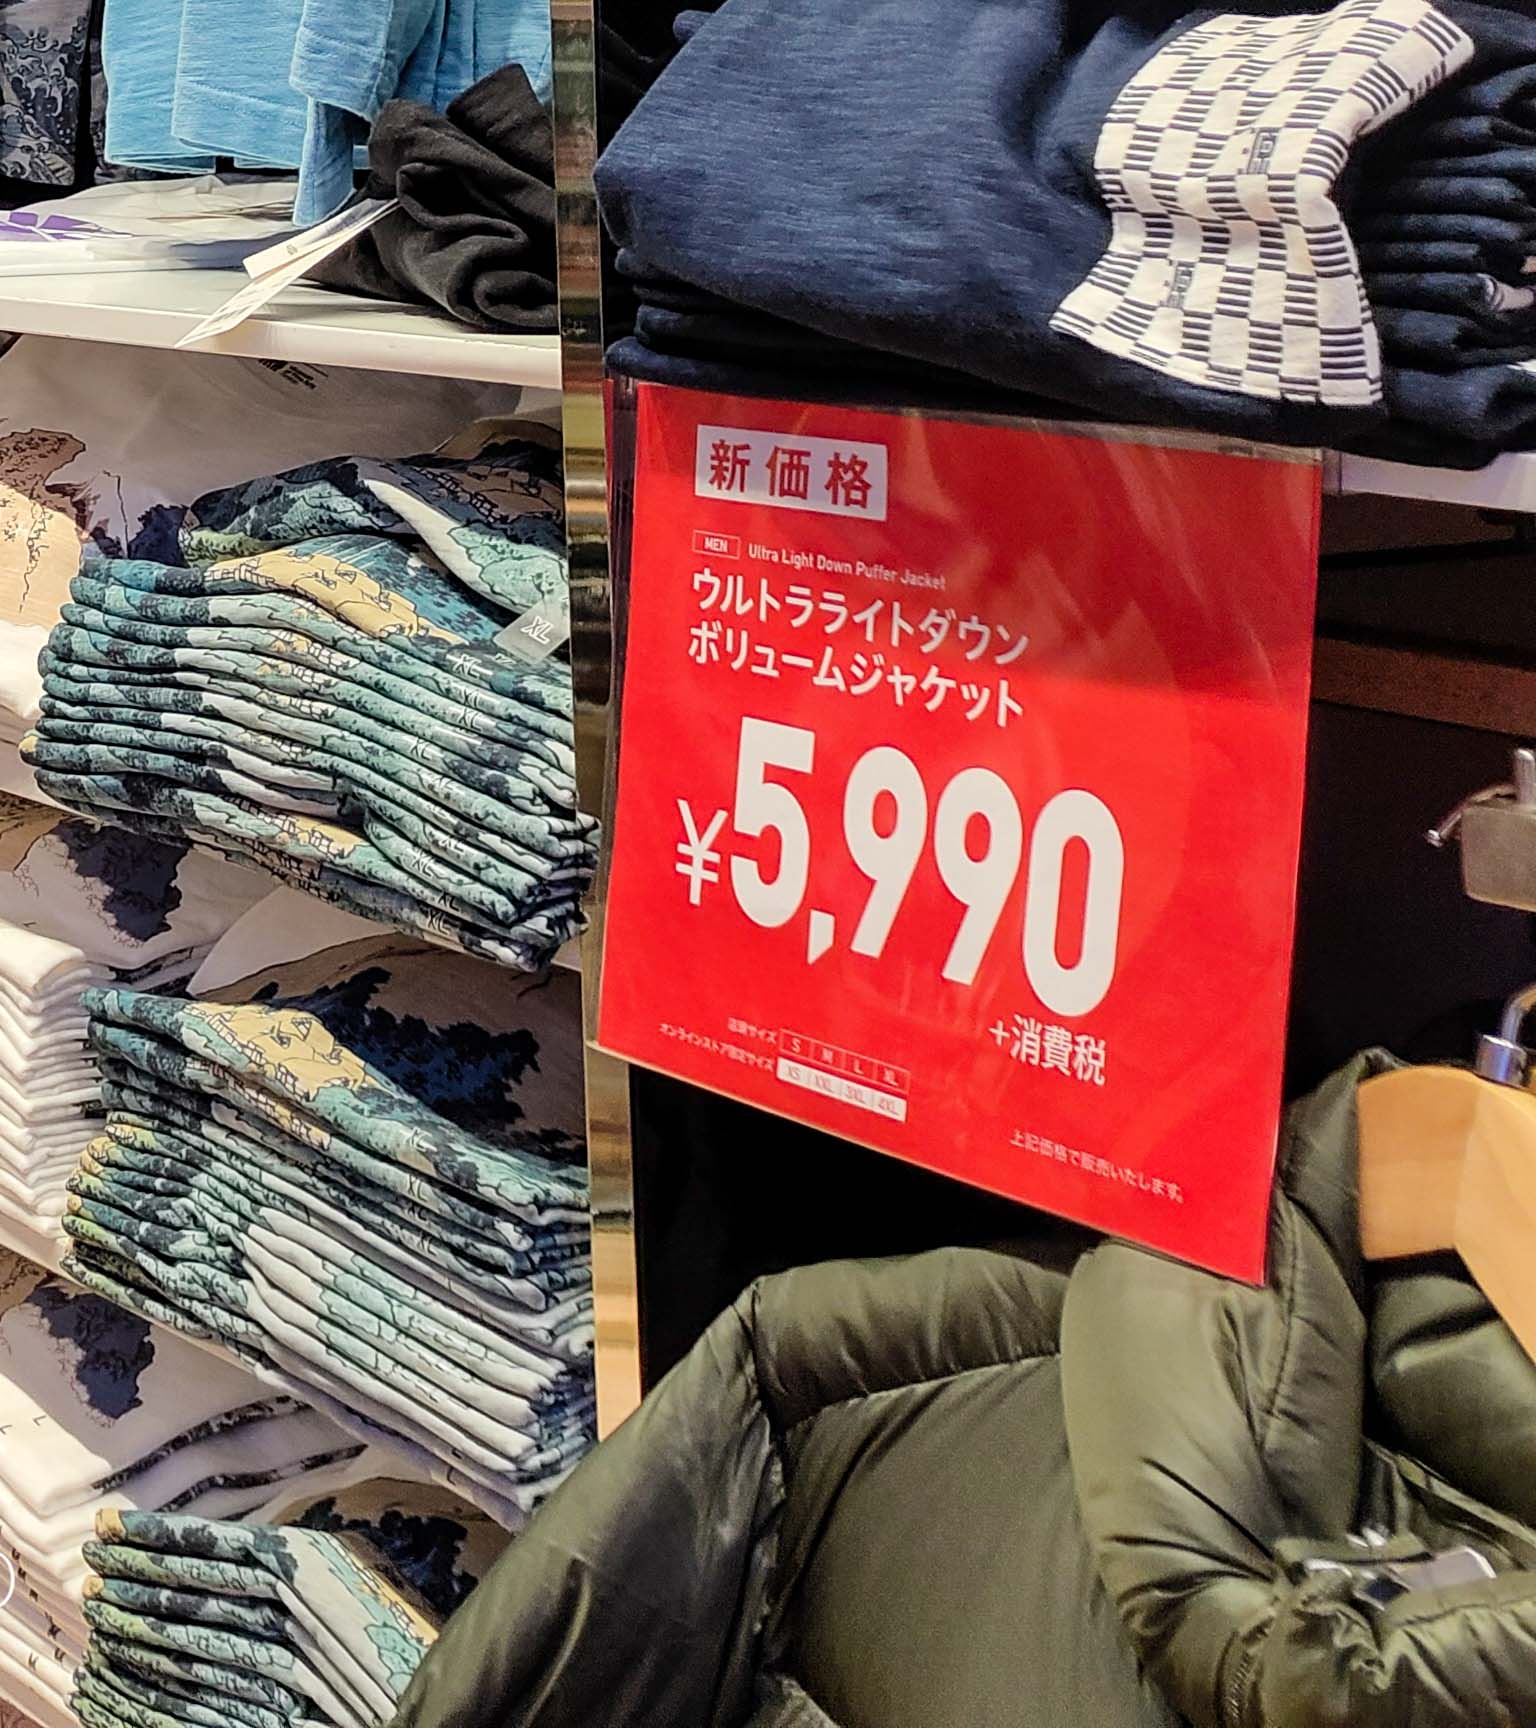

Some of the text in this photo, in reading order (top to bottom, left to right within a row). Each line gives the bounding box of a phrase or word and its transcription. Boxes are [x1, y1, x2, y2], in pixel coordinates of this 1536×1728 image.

[706, 438, 873, 511] 新価格
[703, 536, 946, 592] MEN Ultra Light Down Puffer Jacket
[520, 616, 555, 645] XL
[692, 567, 1029, 665] ウルトラライトダウン
[688, 619, 1024, 728] ボリュームジャケット
[675, 715, 1125, 1018] ¥5,990
[791, 1038, 802, 1053] S
[822, 1047, 833, 1064] M
[853, 1060, 864, 1074] L
[989, 1013, 1106, 1086] +消費税
